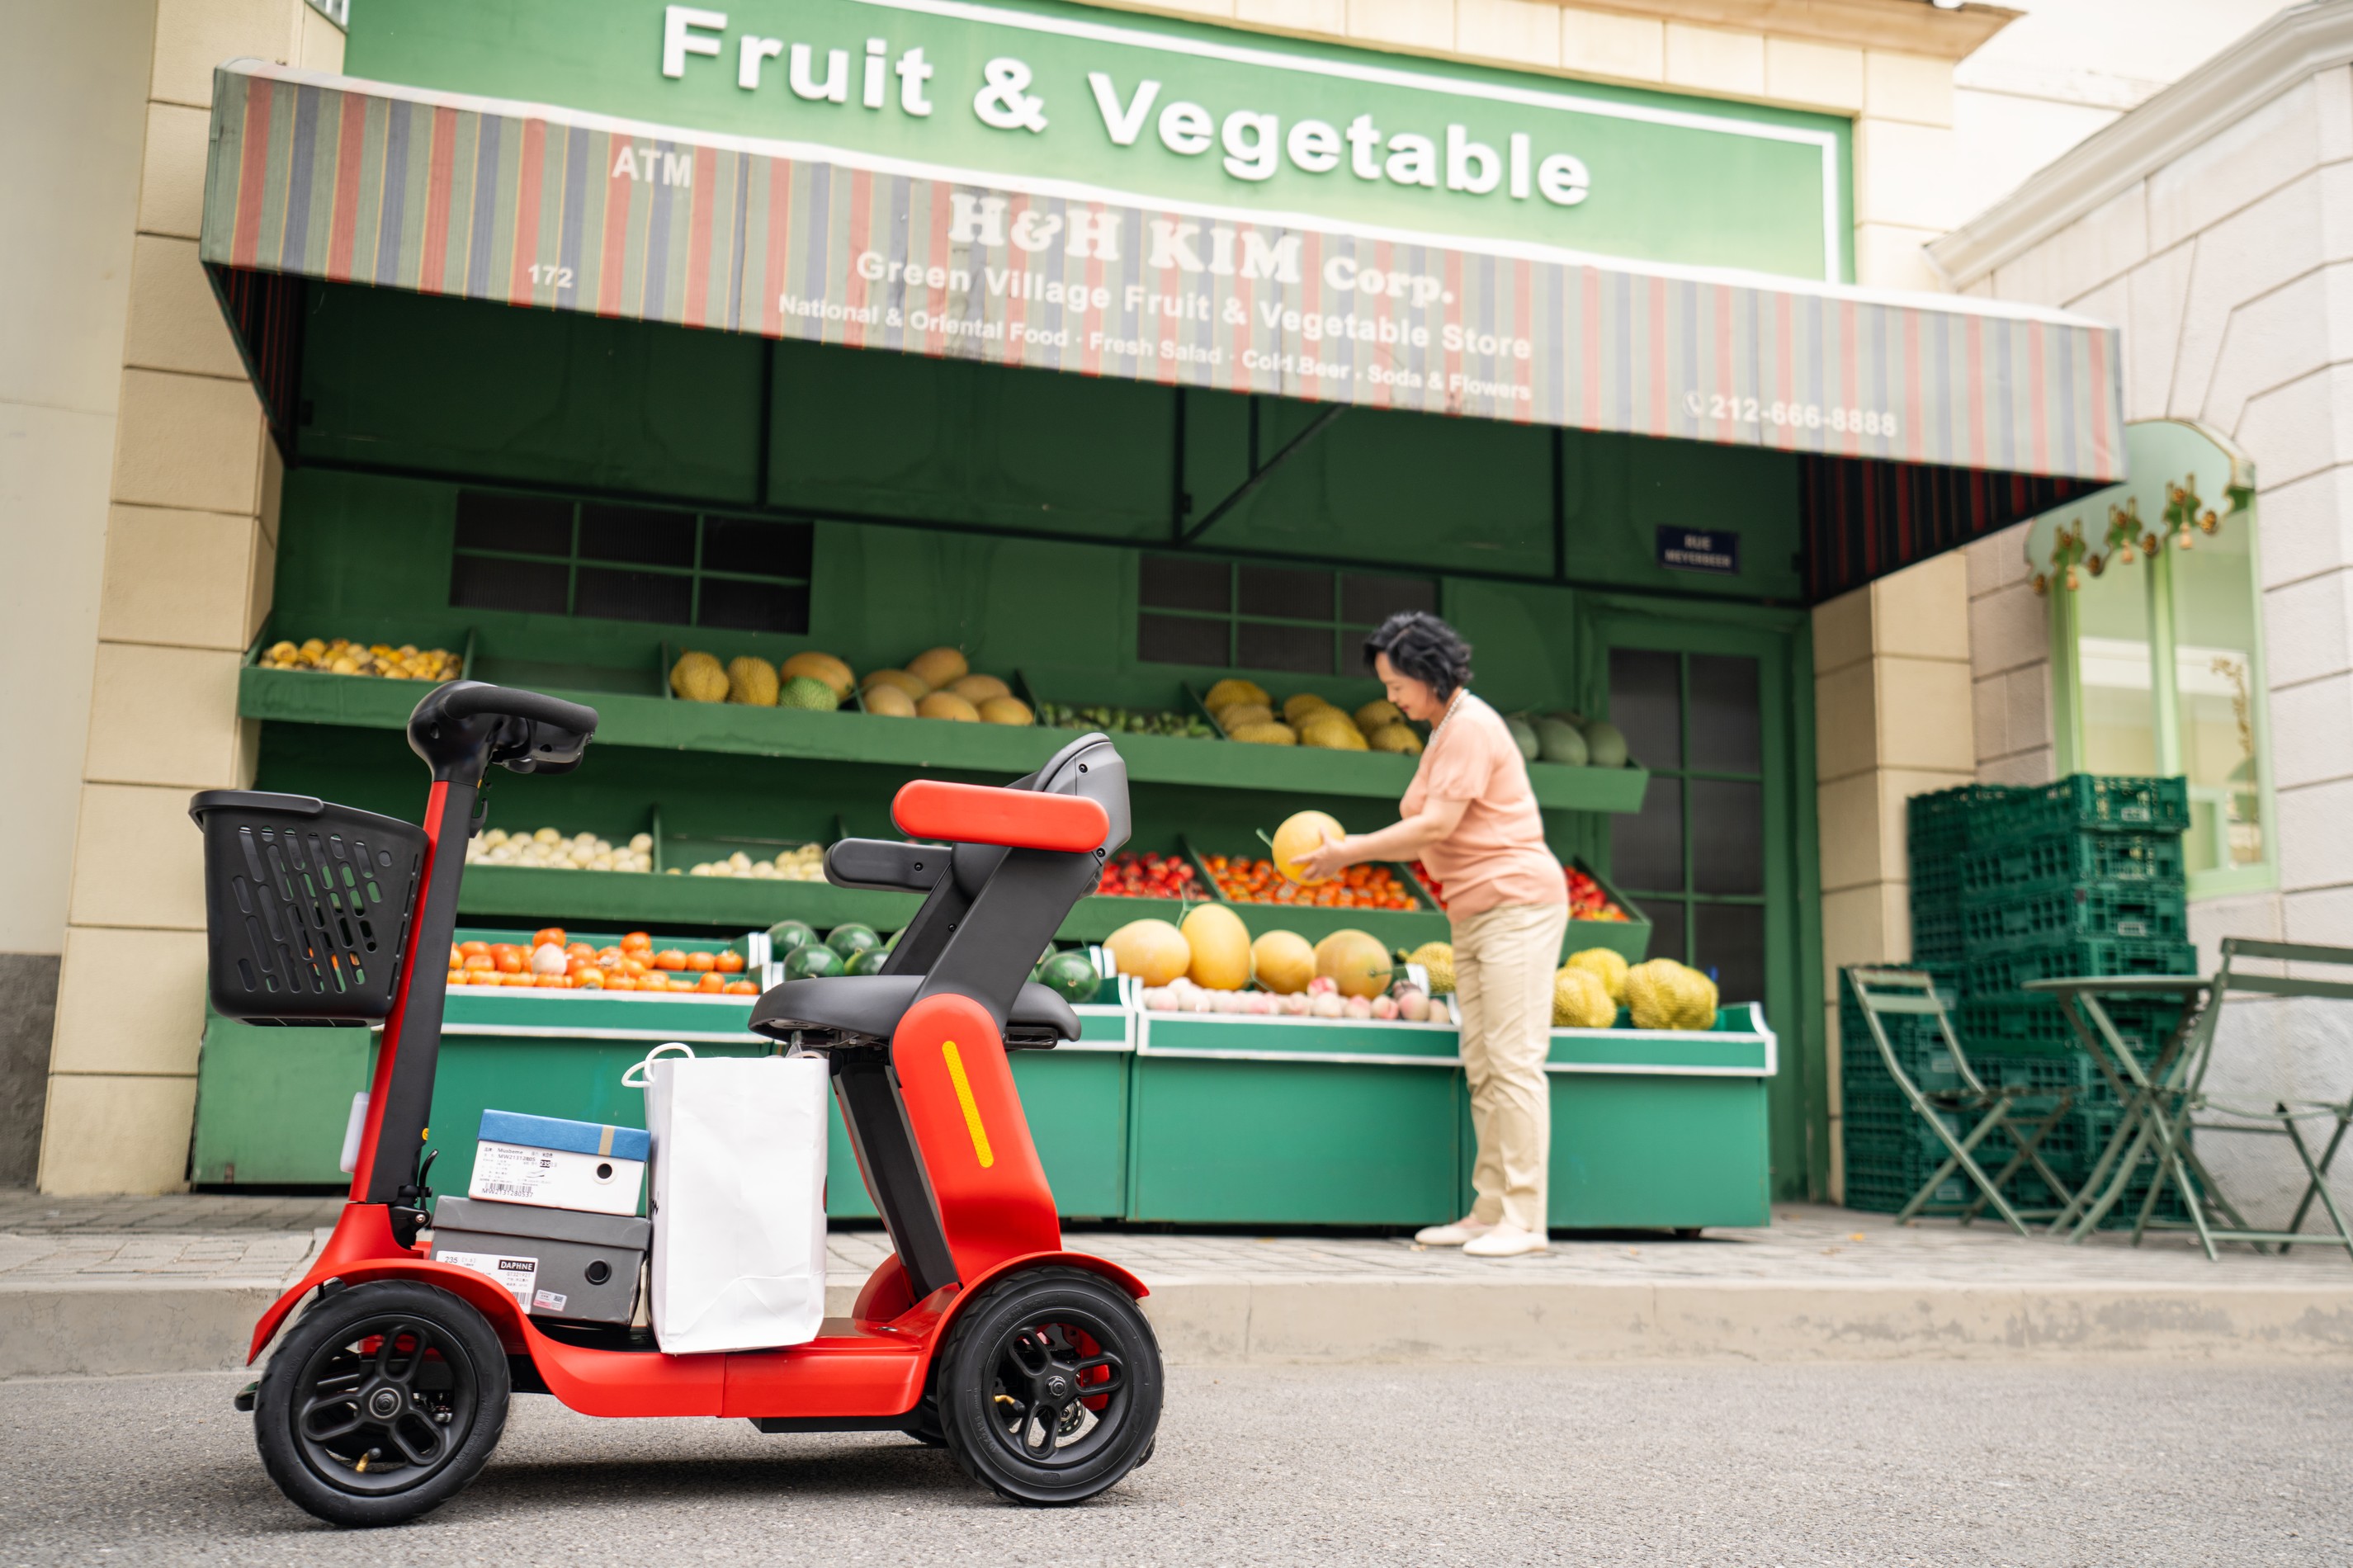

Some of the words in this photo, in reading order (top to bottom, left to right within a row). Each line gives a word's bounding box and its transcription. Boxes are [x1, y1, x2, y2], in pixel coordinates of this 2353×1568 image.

[662, 5, 933, 117] Fruit
[973, 57, 1048, 133] &
[1087, 71, 1591, 206] Vegetable
[612, 144, 692, 189] ATM
[527, 262, 574, 289] 172
[947, 191, 1122, 262] H&H
[1148, 219, 1302, 284] KIM
[1323, 256, 1455, 308] Corp.
[856, 250, 971, 292] Green
[985, 267, 1112, 314] Village
[1124, 285, 1210, 322] Fruit
[1221, 296, 1248, 326] &
[1259, 300, 1431, 349] Vegetable
[1441, 324, 1533, 360] Store
[777, 293, 879, 325] National
[885, 307, 904, 328] &
[910, 309, 1004, 340] Oriental
[1009, 323, 1070, 347] Food
[1089, 331, 1155, 358] Fresh
[1160, 339, 1223, 366] Salad
[1241, 348, 1292, 371] Cold
[1367, 363, 1424, 390] Soda
[1427, 369, 1445, 391] &
[1448, 373, 1533, 401] Flowers
[1709, 394, 1897, 438] 212-666-8888
[500, 1261, 533, 1271] DAPHNE
